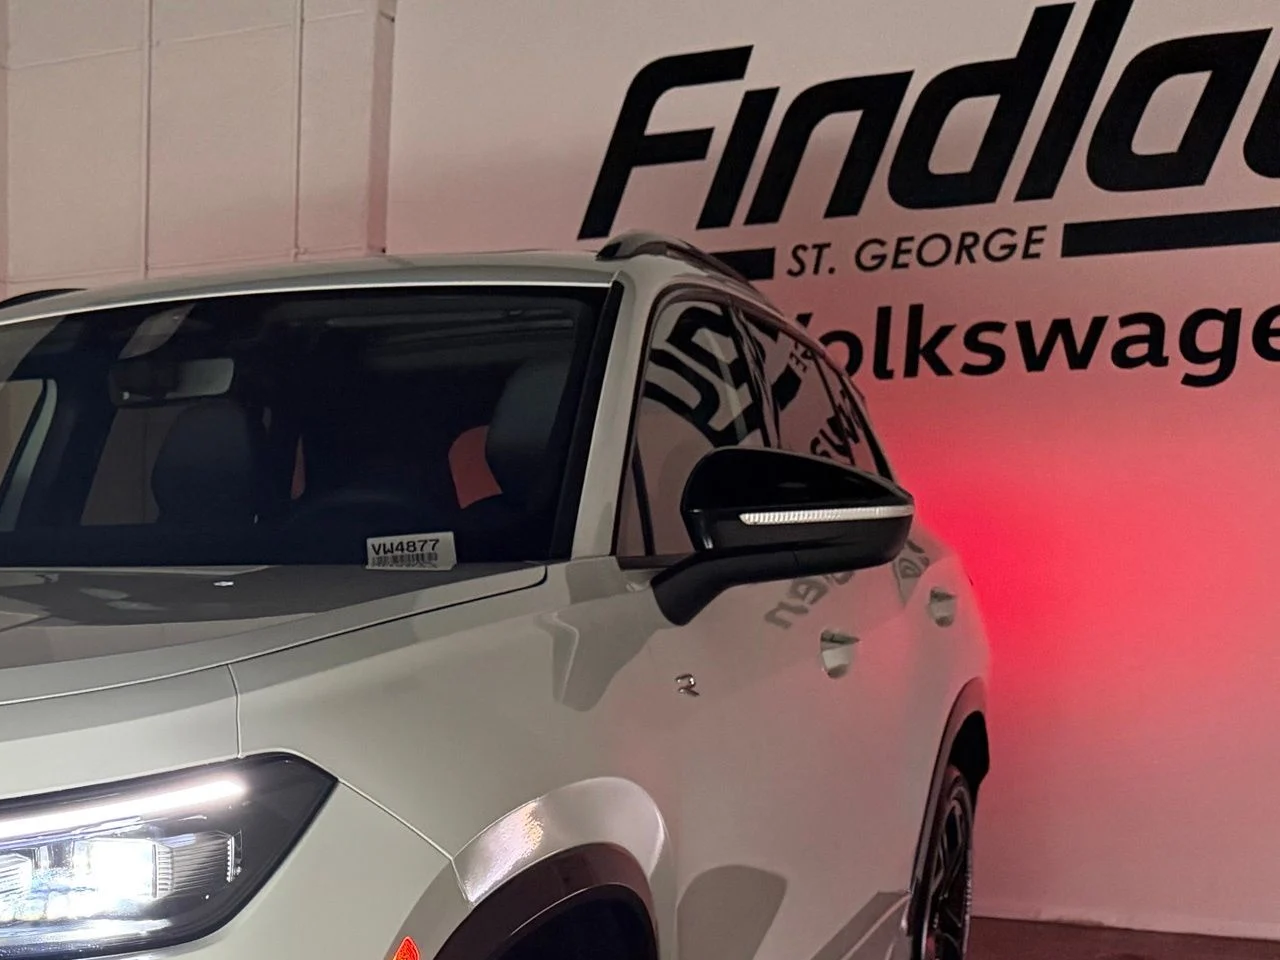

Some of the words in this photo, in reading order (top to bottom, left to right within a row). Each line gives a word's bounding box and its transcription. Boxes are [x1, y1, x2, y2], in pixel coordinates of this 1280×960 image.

[786, 243, 836, 278] ST.
[854, 225, 1047, 272] GEORGE
[795, 303, 1280, 388] olkswage
[371, 539, 440, 555] VW4877
